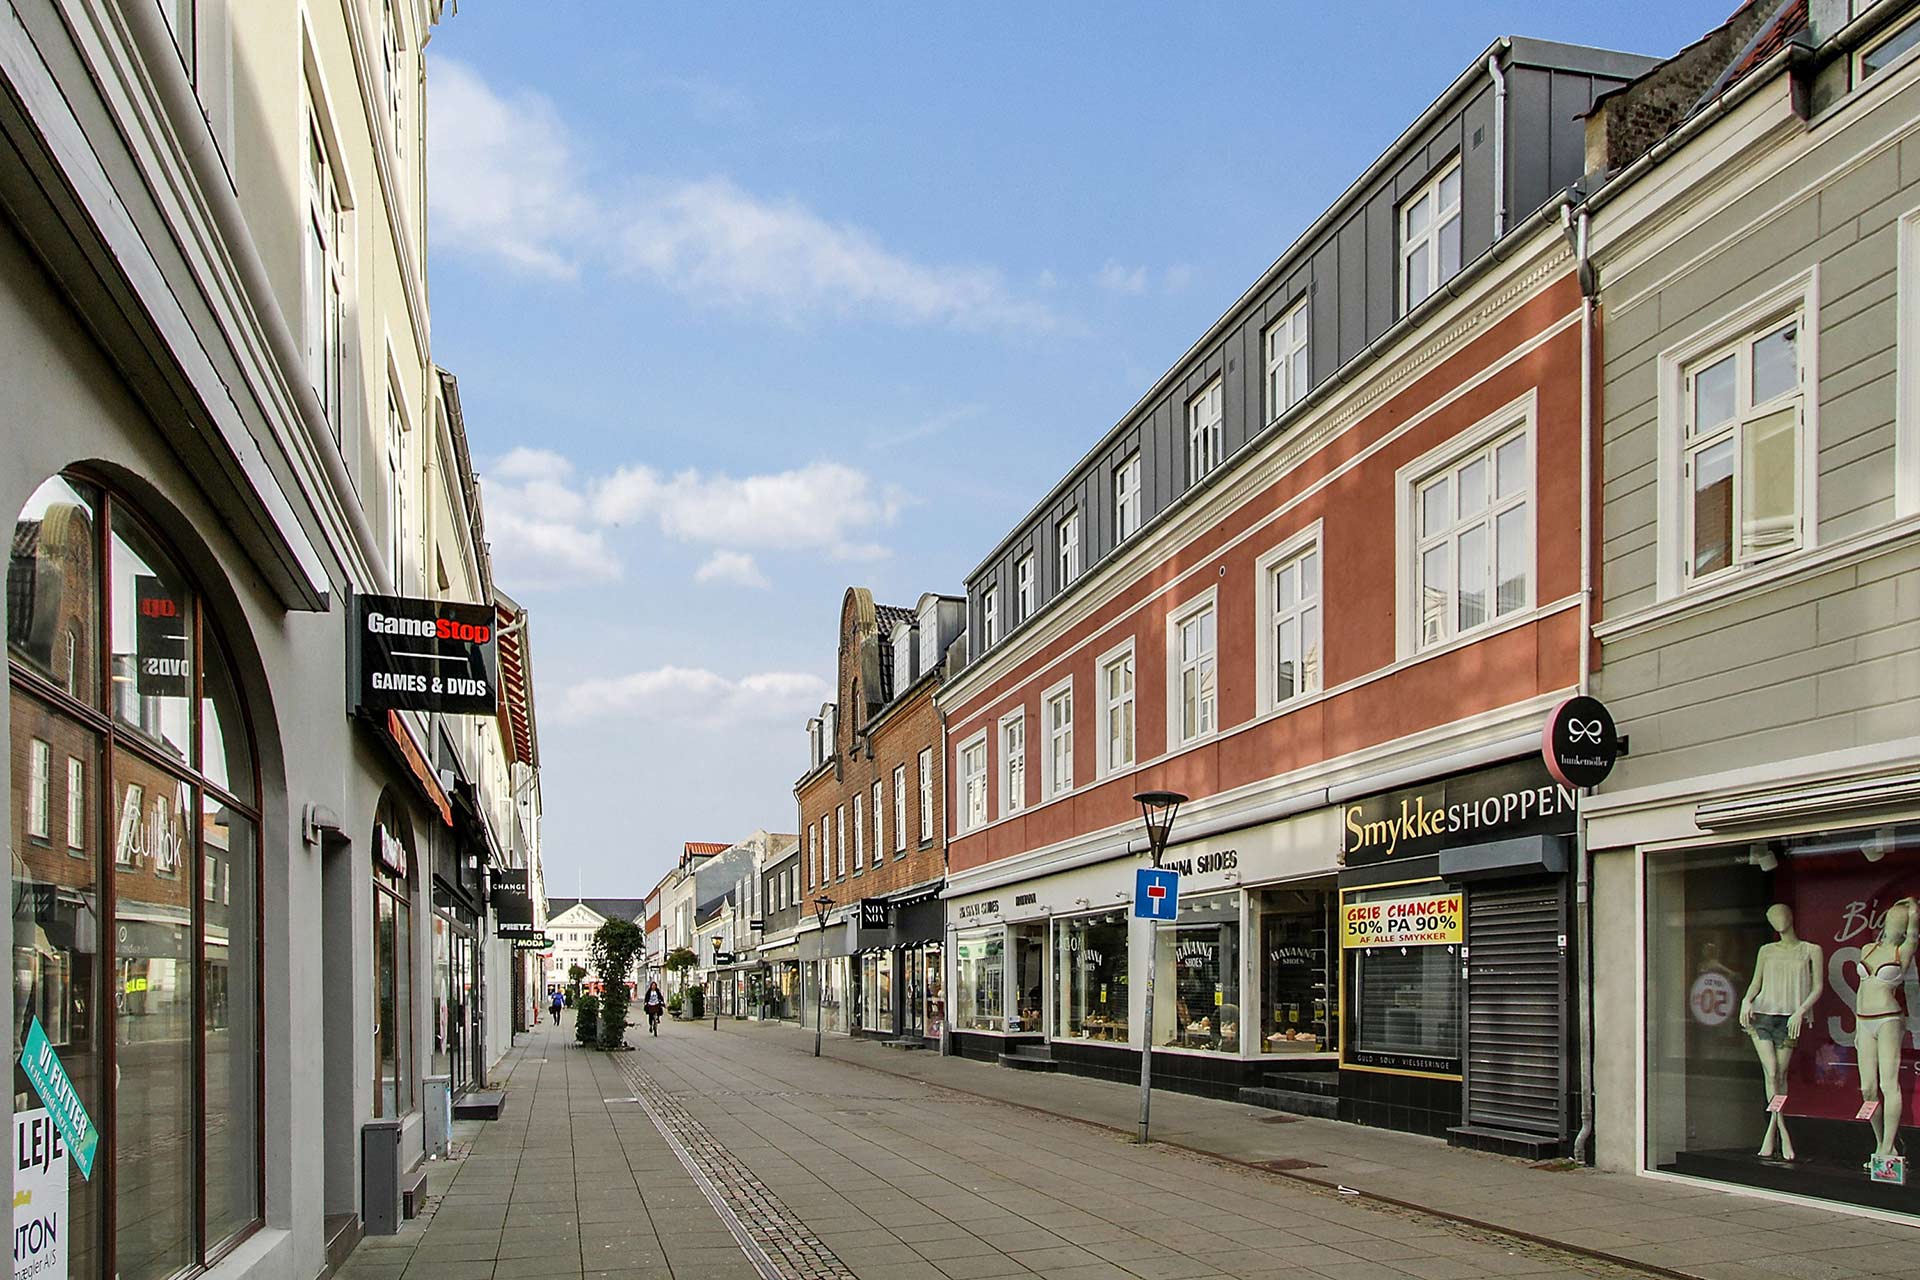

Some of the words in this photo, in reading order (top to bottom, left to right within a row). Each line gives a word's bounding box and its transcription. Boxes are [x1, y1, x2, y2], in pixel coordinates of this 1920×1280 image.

[367, 612, 490, 643] GameStop
[372, 672, 427, 692] GAMES
[431, 677, 443, 694] &
[447, 677, 487, 697] DVDS
[1197, 850, 1238, 874] SHOES
[1347, 906, 1381, 922] GRIB
[1387, 898, 1459, 918] CHANCEN
[1348, 920, 1383, 935] 50%
[1415, 915, 1457, 931] 90%
[1374, 934, 1395, 943] ALLE
[1399, 932, 1447, 942] SMYKKER
[38, 1040, 52, 1075] VI
[49, 1065, 88, 1142] FLYTTER
[18, 1113, 63, 1175] LEJE
